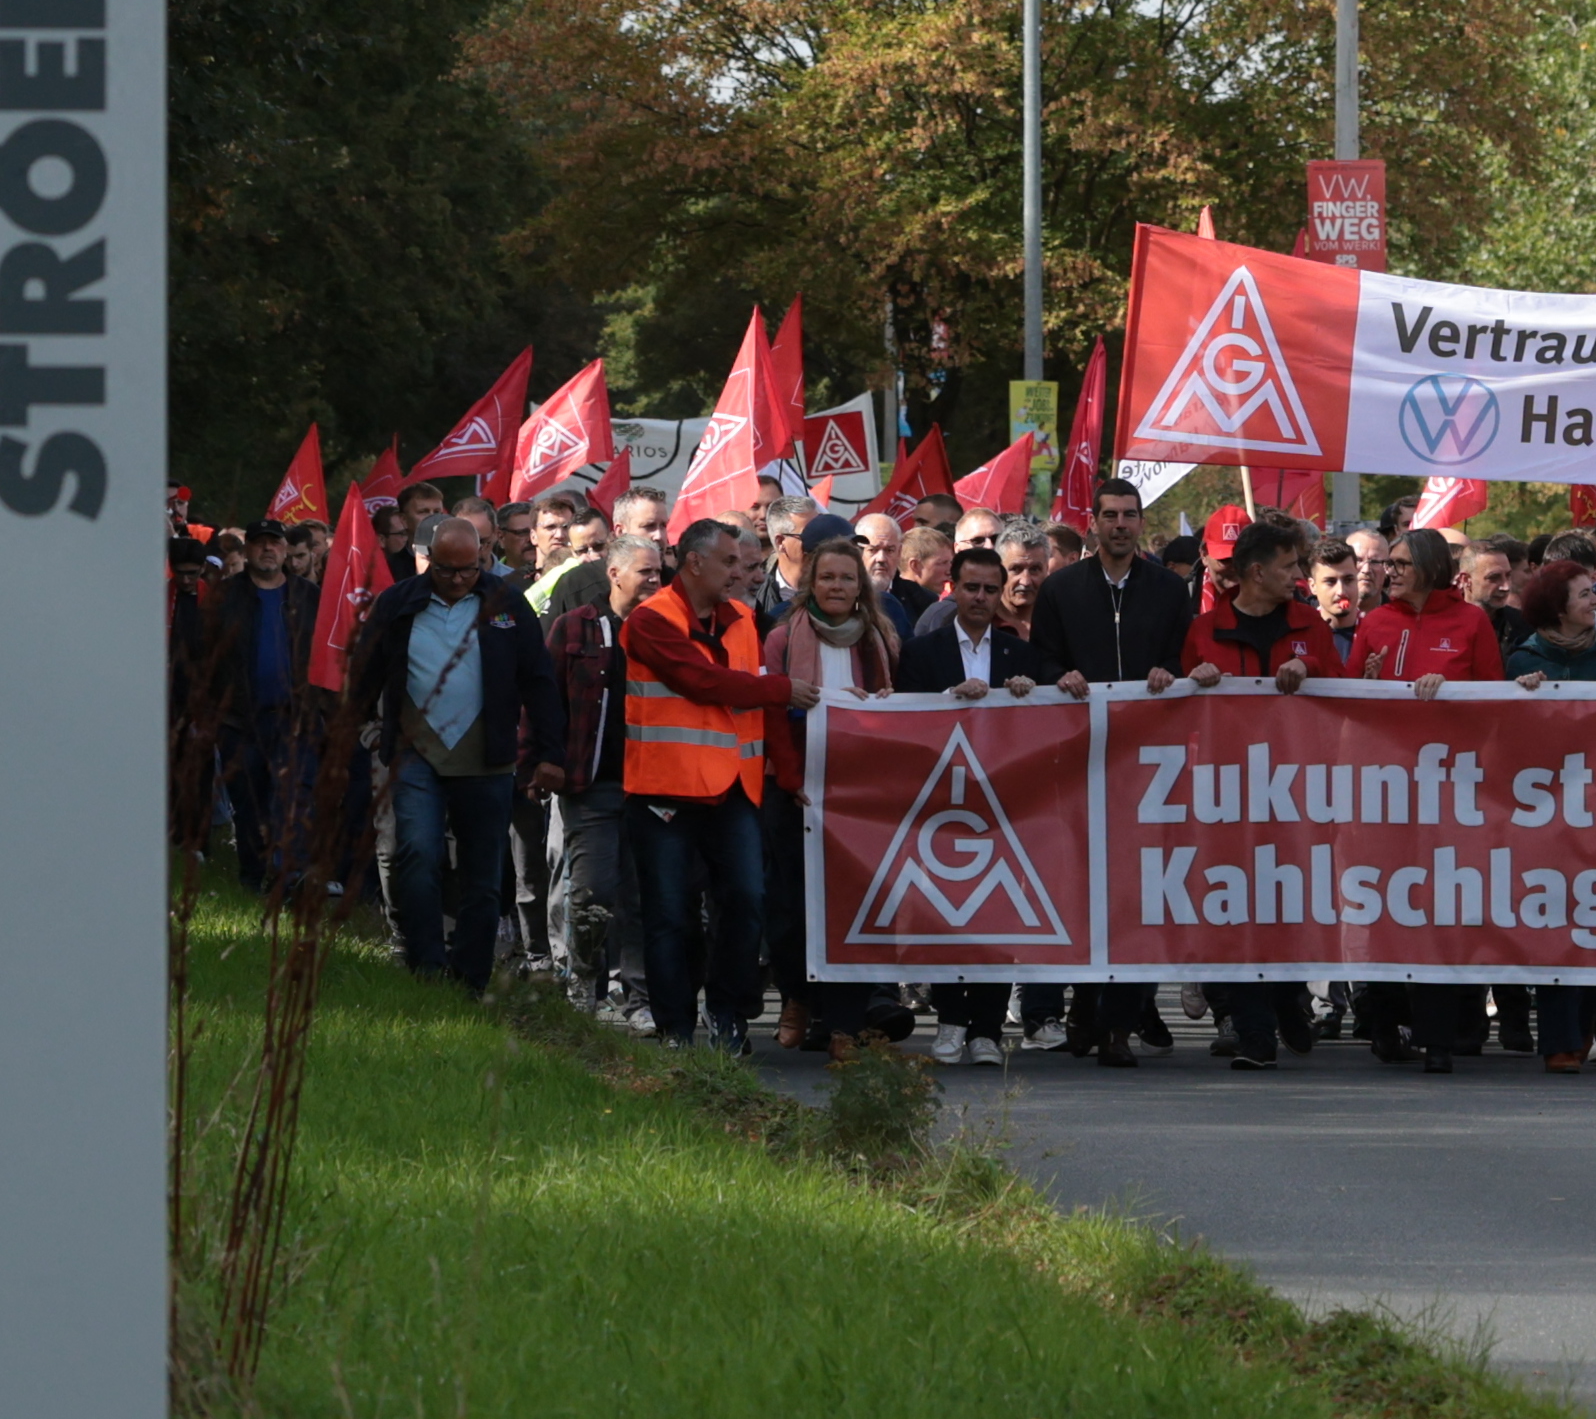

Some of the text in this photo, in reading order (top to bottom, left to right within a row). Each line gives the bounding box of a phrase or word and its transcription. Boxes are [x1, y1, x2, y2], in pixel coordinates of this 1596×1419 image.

[1319, 174, 1371, 200] VW,
[1313, 201, 1379, 218] FINGER
[1314, 218, 1380, 241] WEG
[1314, 241, 1380, 251] VOM WERK!
[1335, 254, 1357, 264] SPD
[1138, 744, 1485, 827] Zukunft
